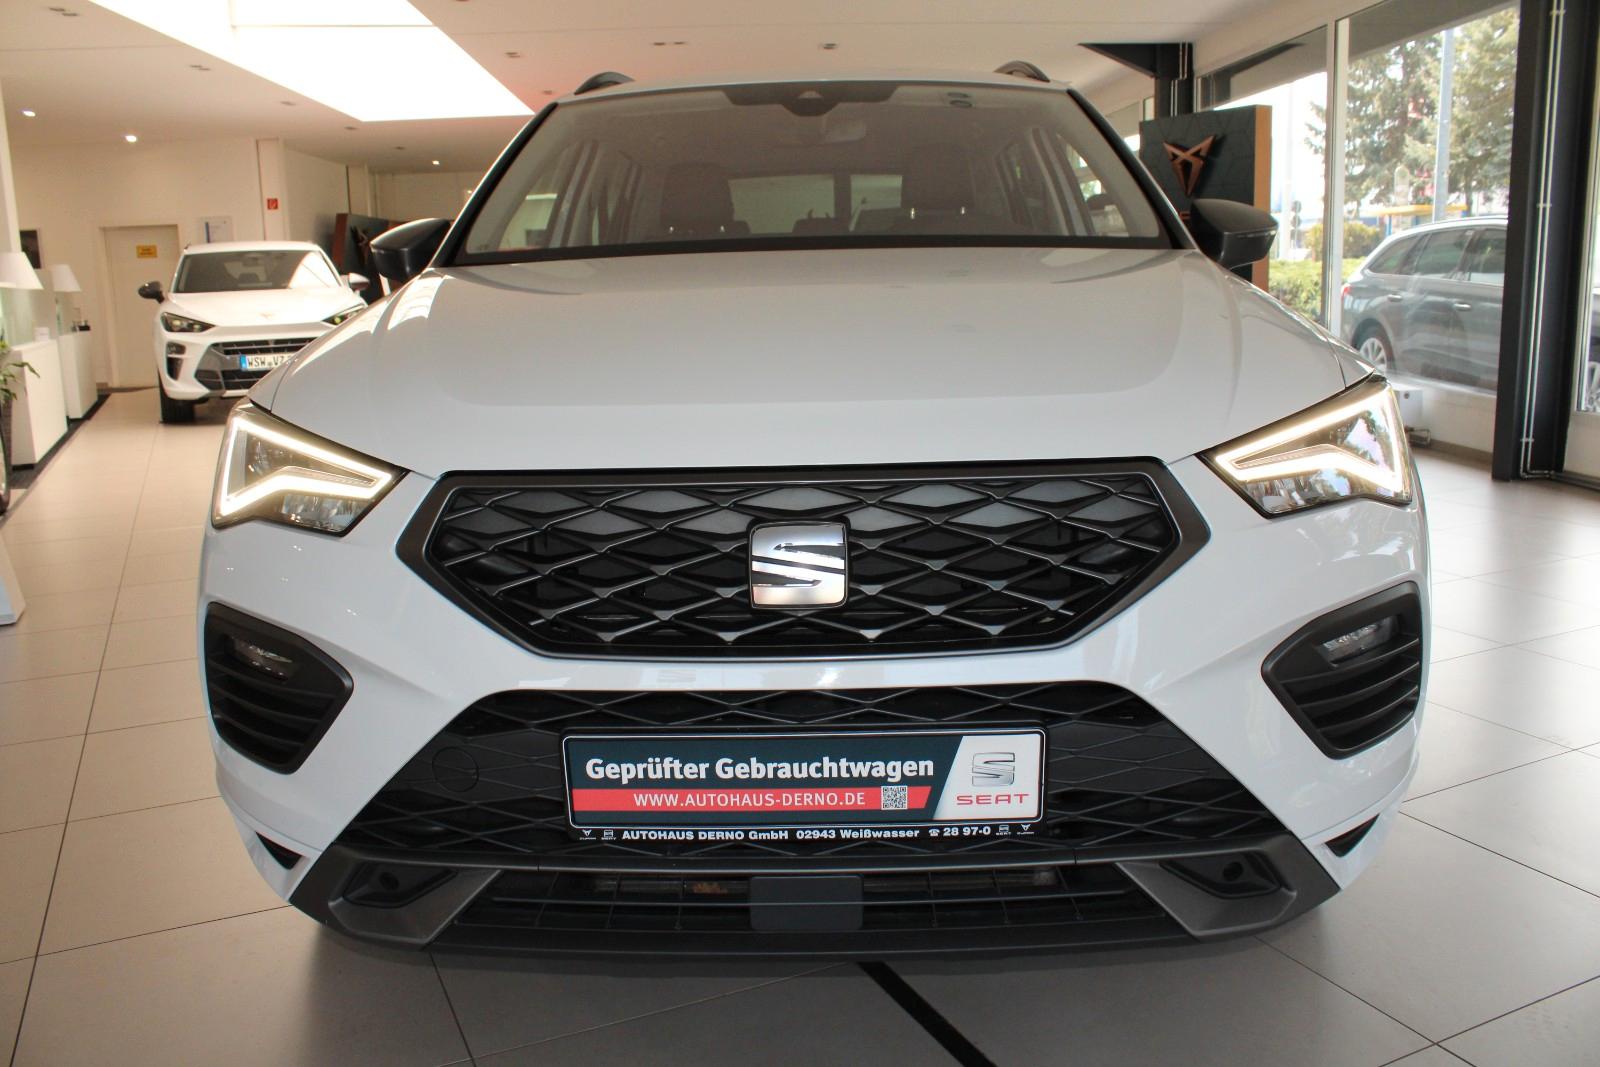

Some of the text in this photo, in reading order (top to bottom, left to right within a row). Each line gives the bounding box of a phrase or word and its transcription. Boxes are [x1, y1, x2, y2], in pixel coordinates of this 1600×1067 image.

[247, 356, 266, 368] WSW
[585, 756, 934, 785] Geprüfter Gebrauchtwagen
[633, 792, 866, 807] WWW.AUTOHAUS-DERNO.DE
[956, 793, 1030, 806] SEAT
[622, 825, 991, 841] AUTOHAUS DERNO GmbH 02943 Weißwasser 28 97-0
